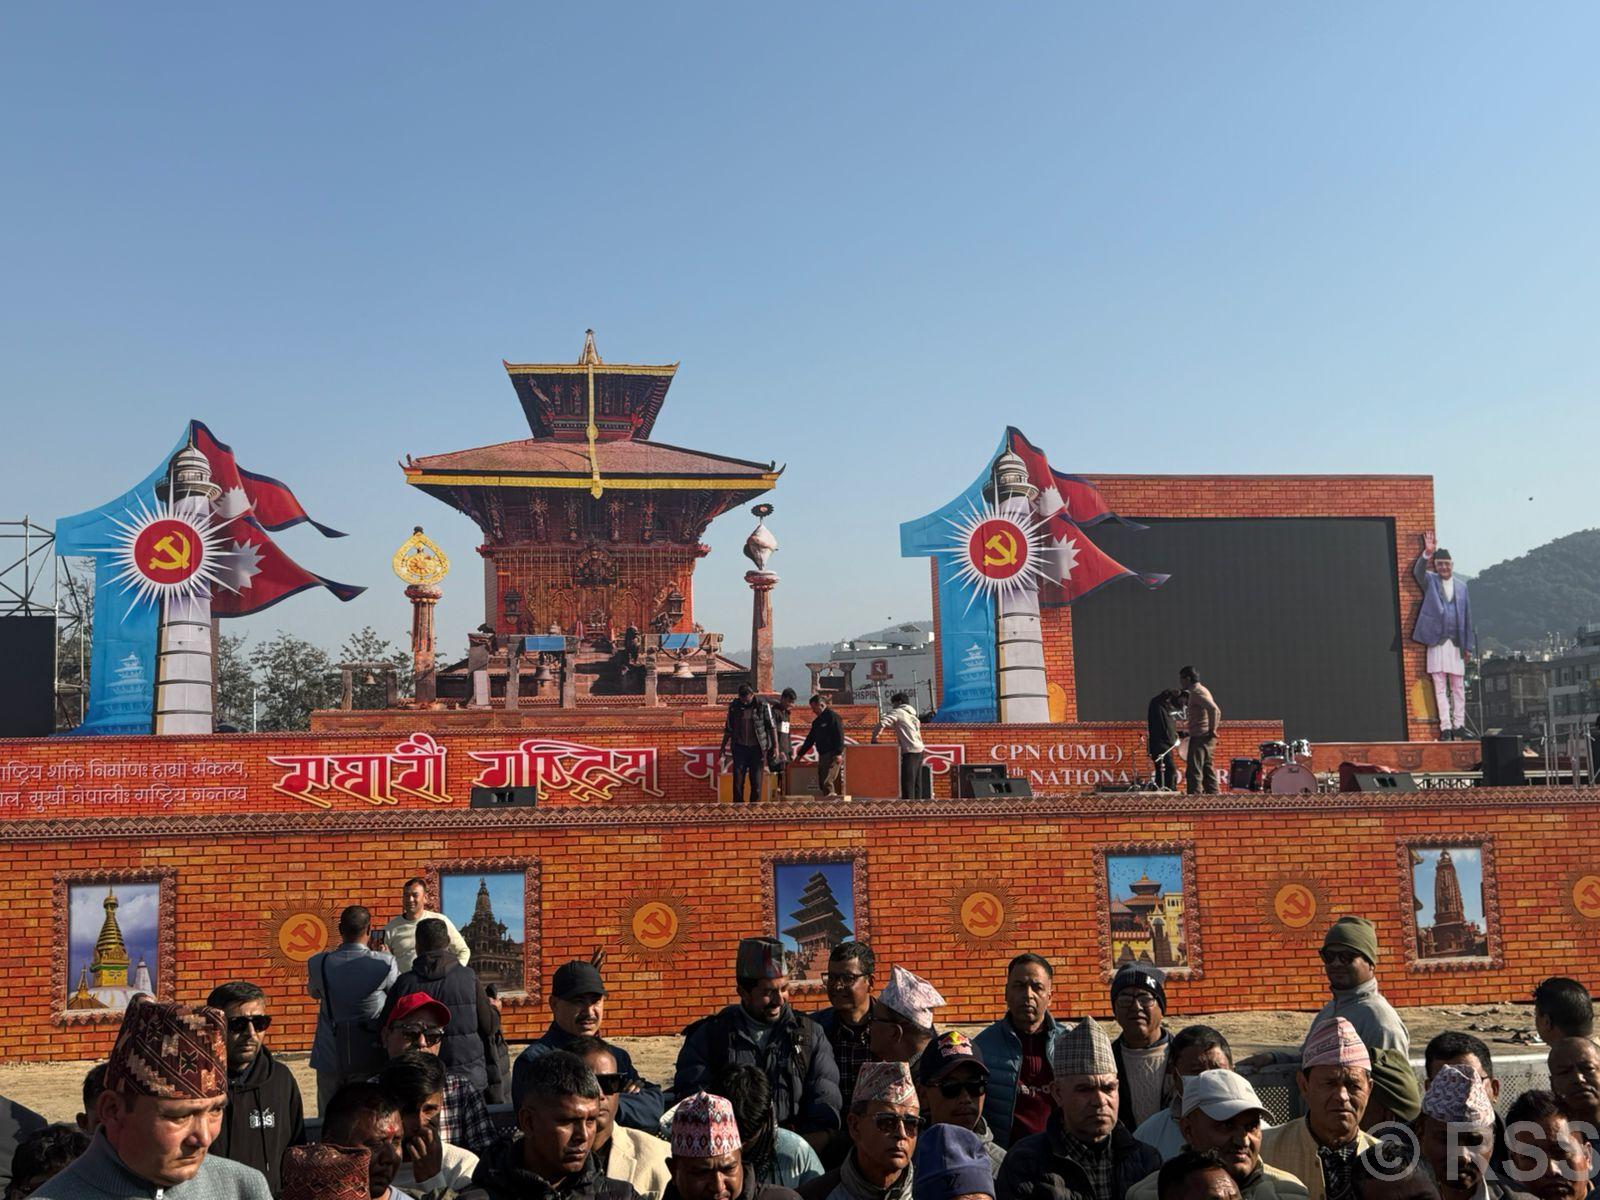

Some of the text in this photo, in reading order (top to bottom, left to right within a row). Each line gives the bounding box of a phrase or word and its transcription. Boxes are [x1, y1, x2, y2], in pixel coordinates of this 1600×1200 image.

[884, 688, 917, 699] COEG
[990, 743, 1123, 765] CPN (UML)
[0, 760, 43, 786] ाष्ट्रिय
[47, 759, 85, 781] शक्ति
[151, 757, 189, 779] हाम्रो
[190, 757, 249, 780] संकल्प,
[1030, 769, 1130, 786] NATIONA
[29, 785, 68, 812] सुखी
[134, 782, 189, 808] राष्ट्रिय
[190, 786, 249, 803] गन्तव्य
